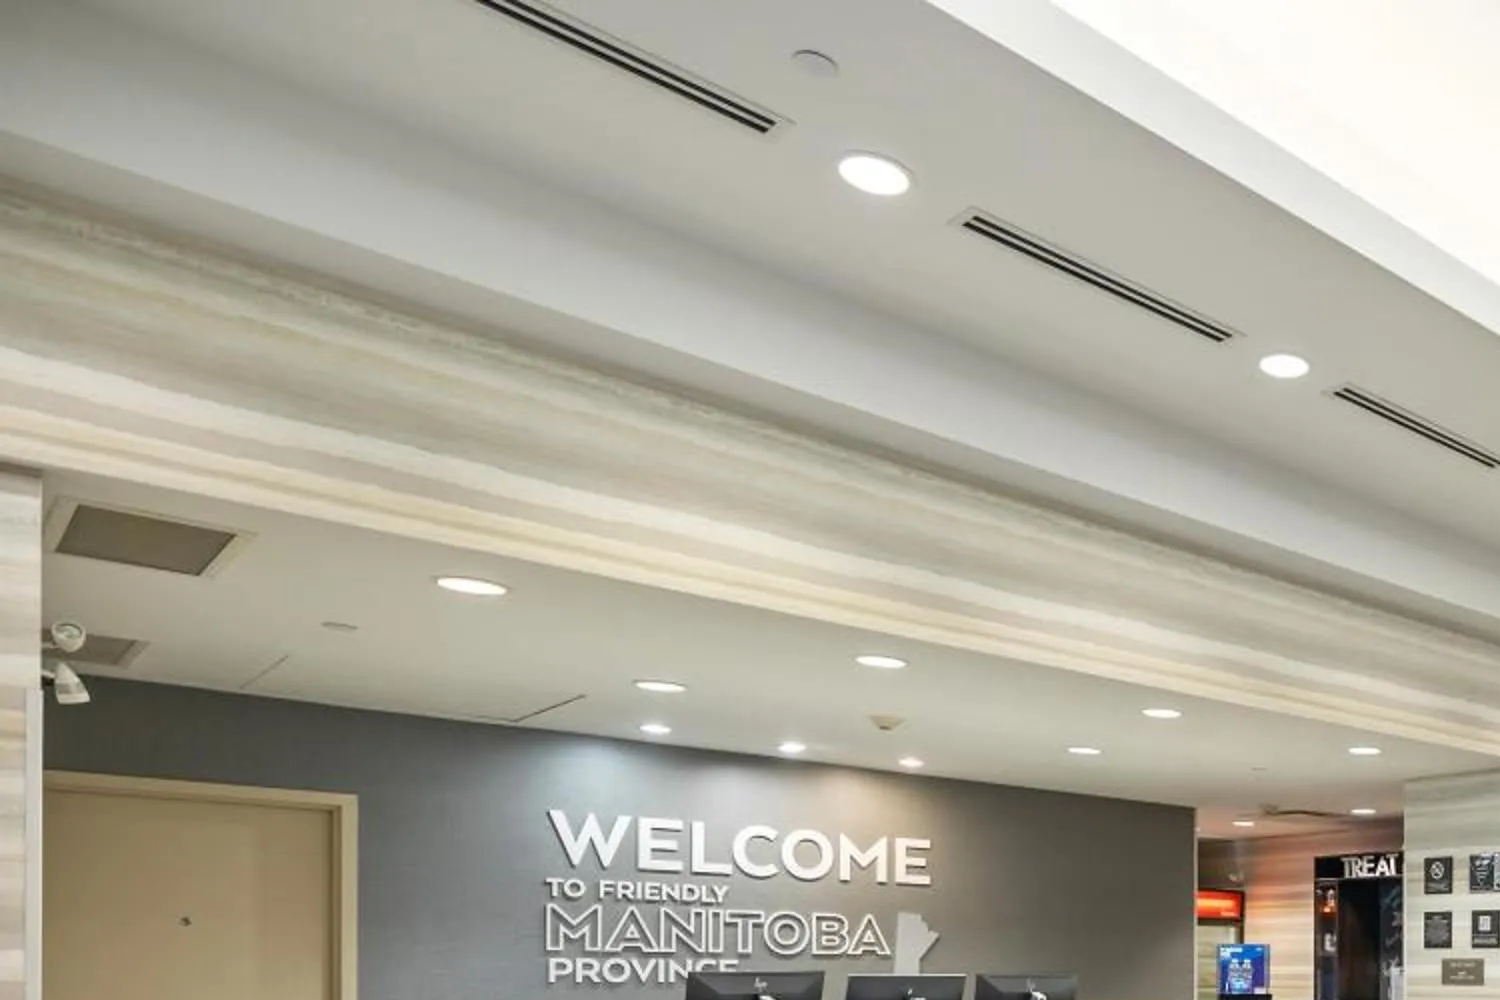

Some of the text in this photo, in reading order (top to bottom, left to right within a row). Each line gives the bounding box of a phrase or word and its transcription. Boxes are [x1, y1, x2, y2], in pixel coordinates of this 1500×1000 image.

[547, 808, 931, 886] WELCOME
[1340, 853, 1399, 879] TREAT
[545, 877, 729, 904] TO FRIENDLY
[545, 903, 891, 957] MANITOBA
